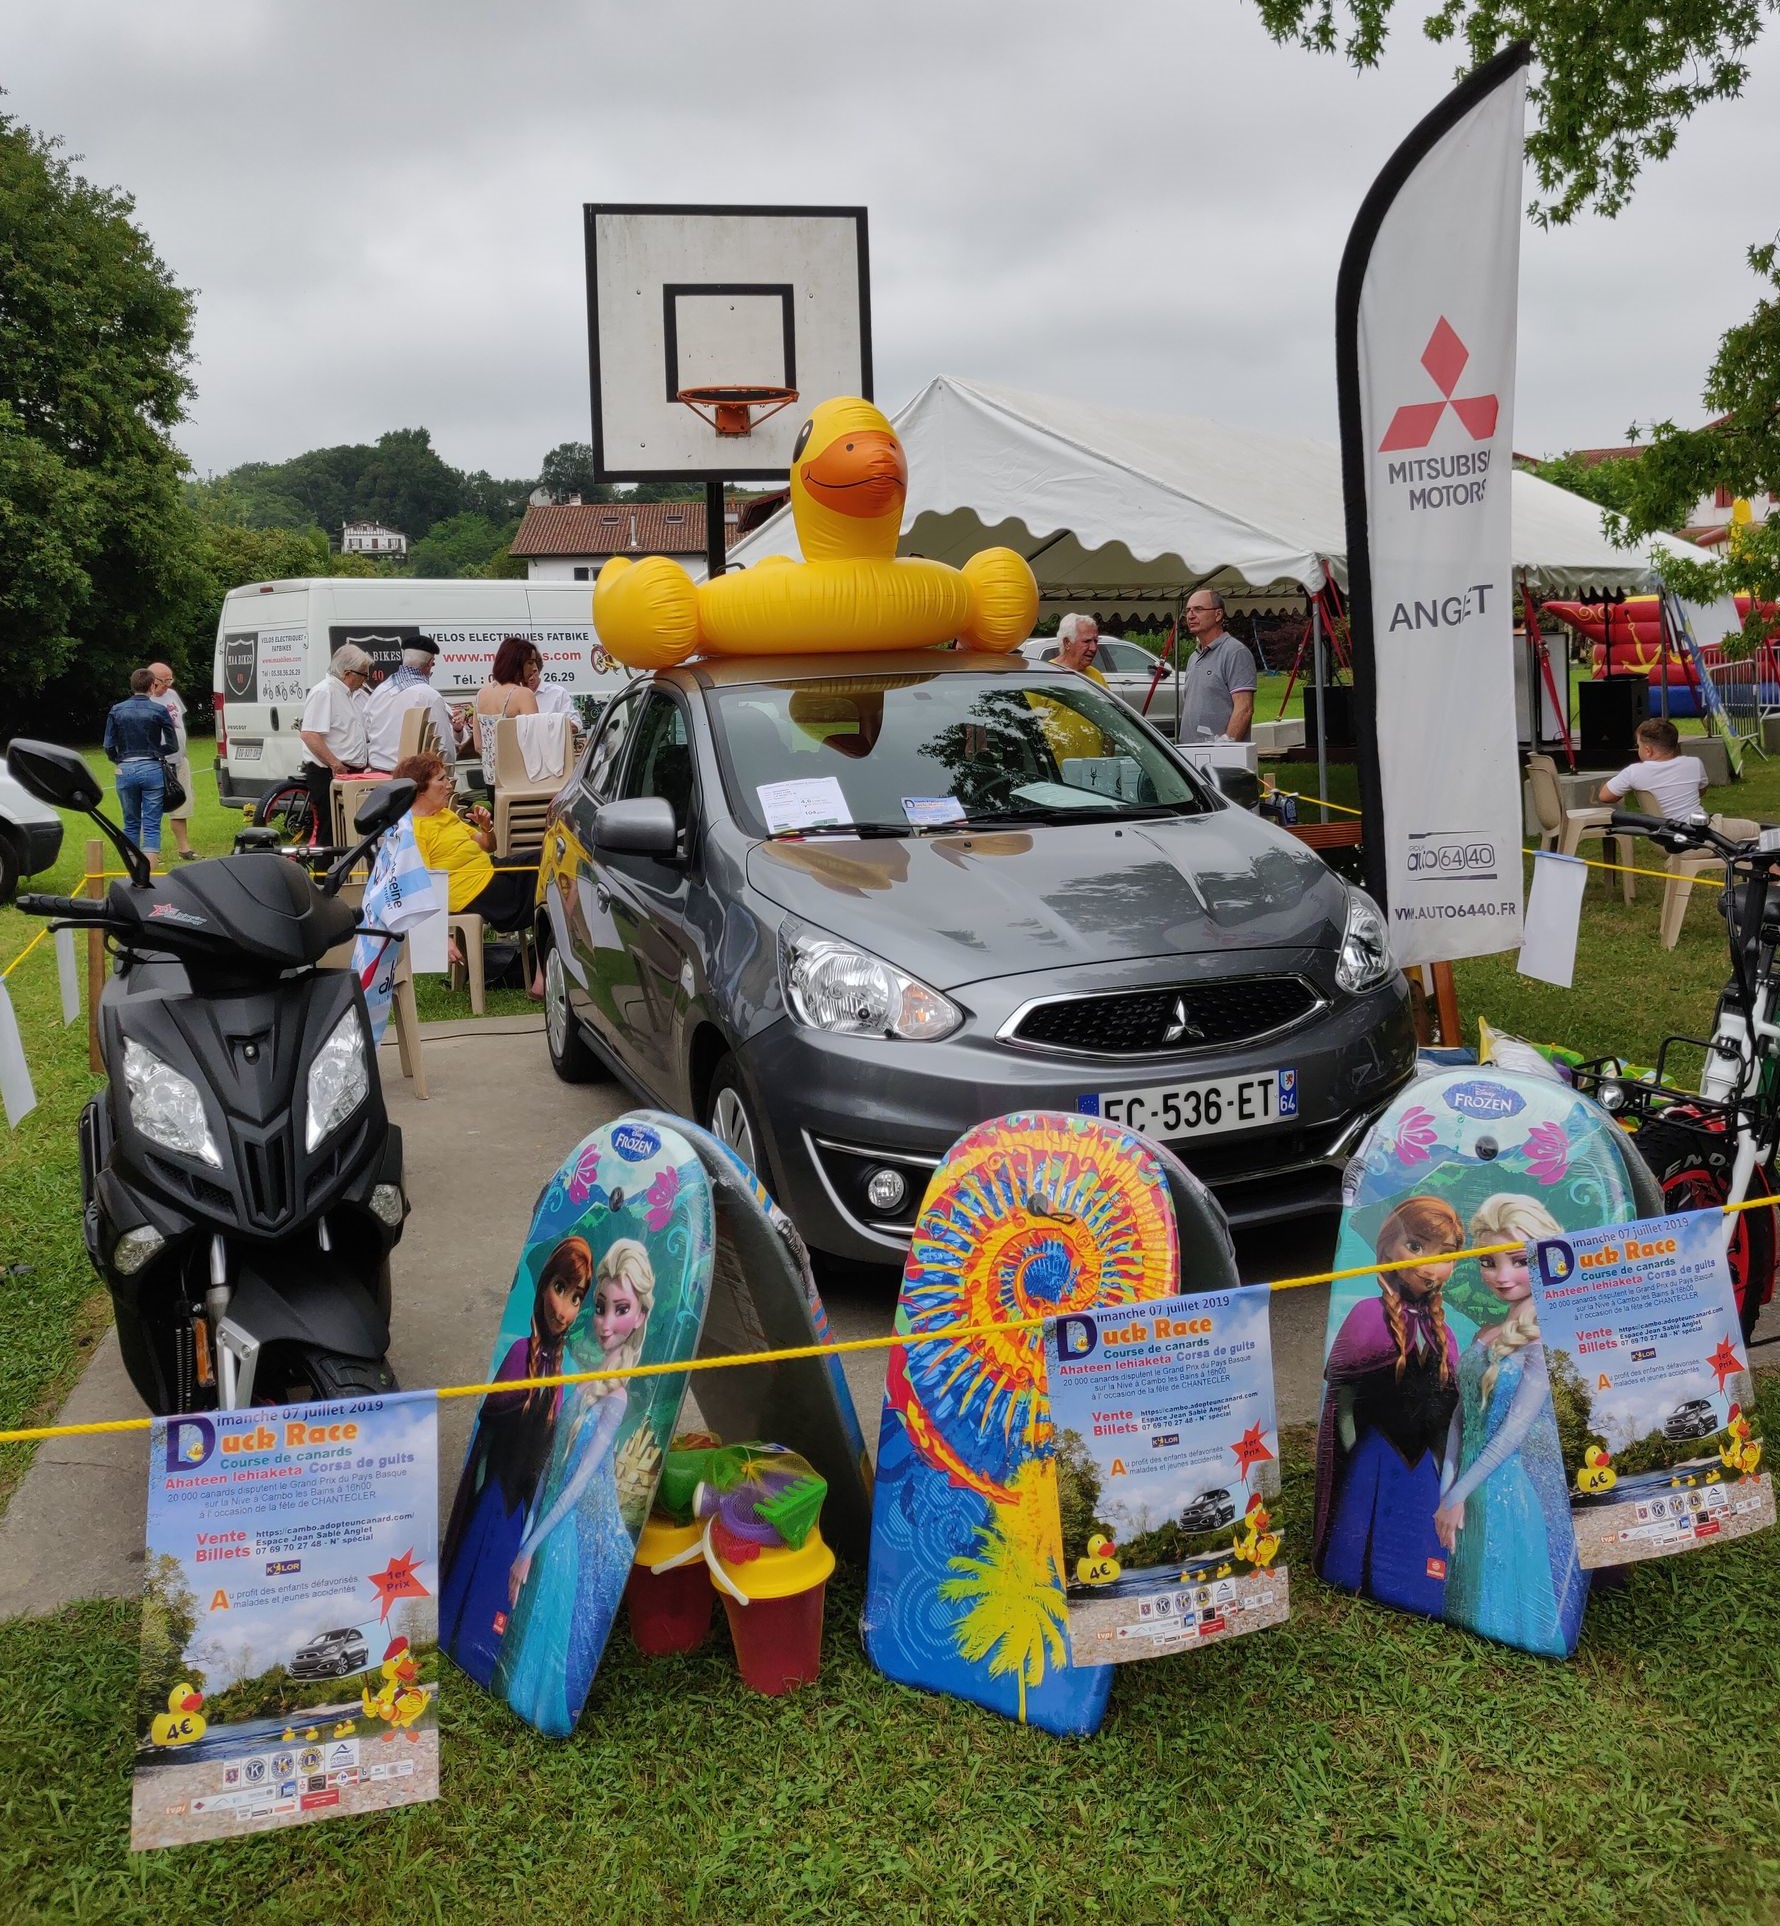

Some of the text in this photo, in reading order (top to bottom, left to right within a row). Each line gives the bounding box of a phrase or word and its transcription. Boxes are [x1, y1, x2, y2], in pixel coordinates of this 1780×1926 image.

[373, 651, 401, 661] BIKES
[372, 670, 384, 680] 40
[1280, 1093, 1296, 1112] 64
[1454, 1093, 1512, 1112] FROZEN
[615, 1133, 653, 1154] FROZEN
[1618, 1228, 1630, 1239] 07
[1632, 1222, 1661, 1239] juillet
[1664, 1217, 1689, 1230] 2019
[1624, 1239, 1677, 1261] Race
[1581, 1258, 1676, 1281] Course de canards
[1545, 1285, 1589, 1299] Ahateen
[1592, 1276, 1643, 1291] lehiaketa
[1647, 1269, 1677, 1281] Corsa
[1679, 1265, 1691, 1274] de
[1149, 1305, 1162, 1316] 07
[1166, 1302, 1199, 1317] juillet
[1203, 1296, 1230, 1308] 2019
[1155, 1318, 1212, 1339] Race
[1576, 1327, 1612, 1341] Vente
[1104, 1338, 1210, 1359] Course de canards
[1578, 1339, 1618, 1354] Billets
[1645, 1328, 1661, 1336] Jean
[1060, 1364, 1112, 1376] Ahateen
[1115, 1355, 1172, 1369] lehiaketa
[1176, 1350, 1210, 1361] Corsa
[1214, 1346, 1226, 1356] de
[1719, 1360, 1732, 1369] Prix
[1181, 1374, 1230, 1388] CHANTECLER
[283, 1407, 299, 1420] 07
[304, 1405, 345, 1421] juillet
[349, 1400, 384, 1414] 2019
[1092, 1410, 1133, 1423] Vente
[1093, 1423, 1139, 1436] Billets
[1209, 1404, 1230, 1414] Anglet
[286, 1423, 358, 1447] Race
[1142, 1423, 1150, 1431] 07
[1244, 1439, 1256, 1448] 1er
[1244, 1448, 1260, 1458] Prix
[221, 1447, 353, 1469] Course de canards
[165, 1475, 228, 1490] Ahateen
[233, 1466, 303, 1481] lehiaketa
[309, 1460, 352, 1473] Corsa
[357, 1457, 374, 1468] de
[1590, 1470, 1608, 1488] 4€
[201, 1489, 236, 1499] canards
[320, 1476, 336, 1485] Prix
[376, 1469, 408, 1480] Basque
[312, 1490, 376, 1506] CHANTECLER
[196, 1530, 247, 1545] Vente
[196, 1546, 252, 1562] Billets
[256, 1537, 289, 1548] Espace
[292, 1531, 314, 1542] Jean
[344, 1525, 373, 1537] Anglet
[256, 1547, 267, 1555] 07
[270, 1545, 281, 1553] 69
[284, 1543, 295, 1551] 70
[297, 1541, 308, 1549] 27
[311, 1540, 322, 1548] 48
[388, 1569, 407, 1580] 1er
[1090, 1562, 1111, 1579] 4€
[260, 1586, 276, 1596] des
[386, 1580, 410, 1592] Prix
[166, 1718, 193, 1740] 4€
